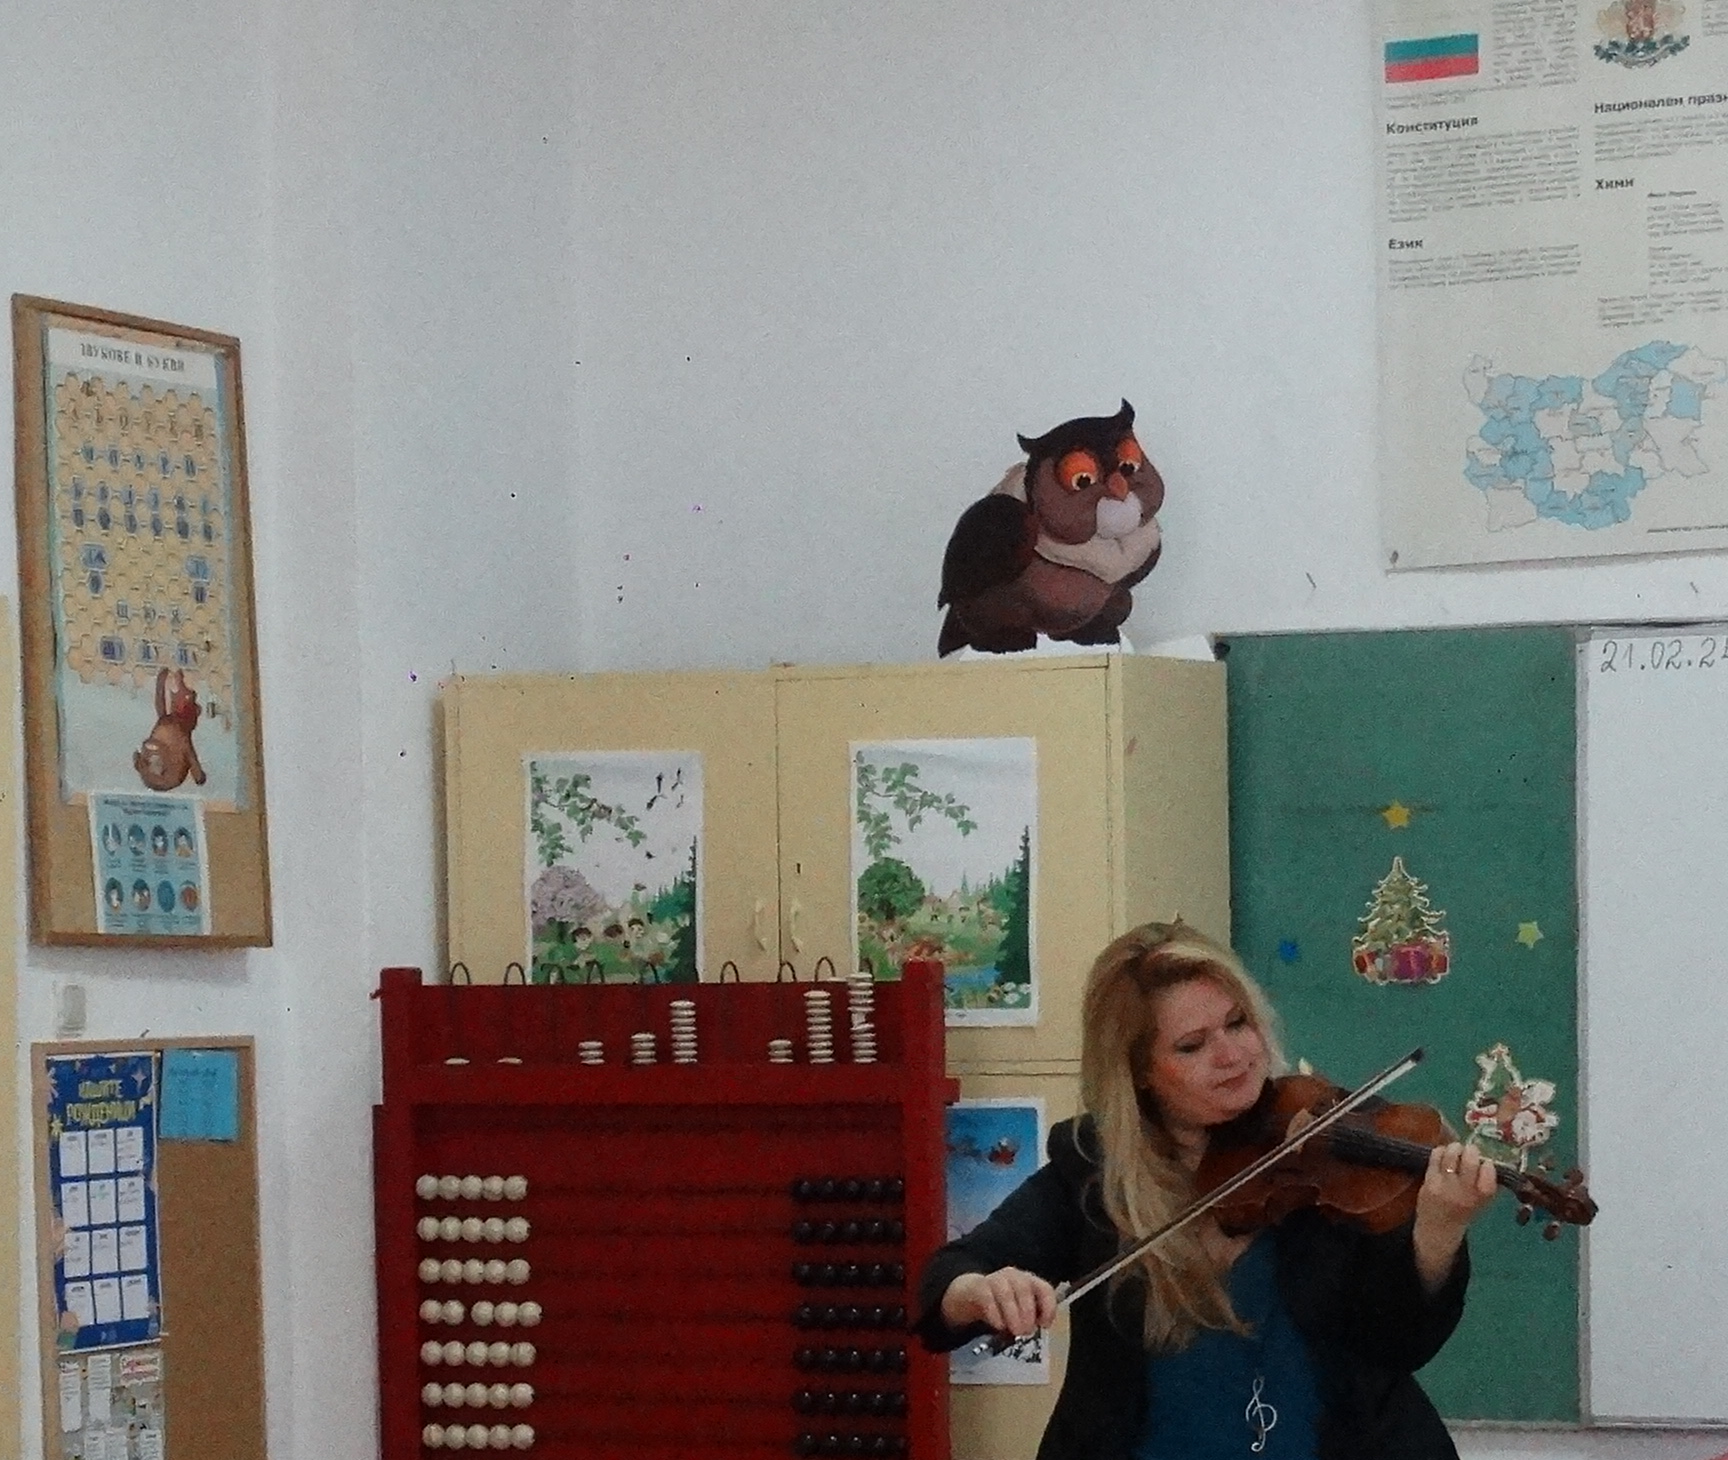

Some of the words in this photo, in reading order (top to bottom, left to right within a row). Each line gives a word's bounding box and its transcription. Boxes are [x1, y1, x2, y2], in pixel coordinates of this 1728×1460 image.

[1594, 97, 1683, 114] Национален
[1386, 117, 1478, 134] Конституция
[1595, 178, 1634, 190] Химн
[1388, 239, 1423, 250] Език
